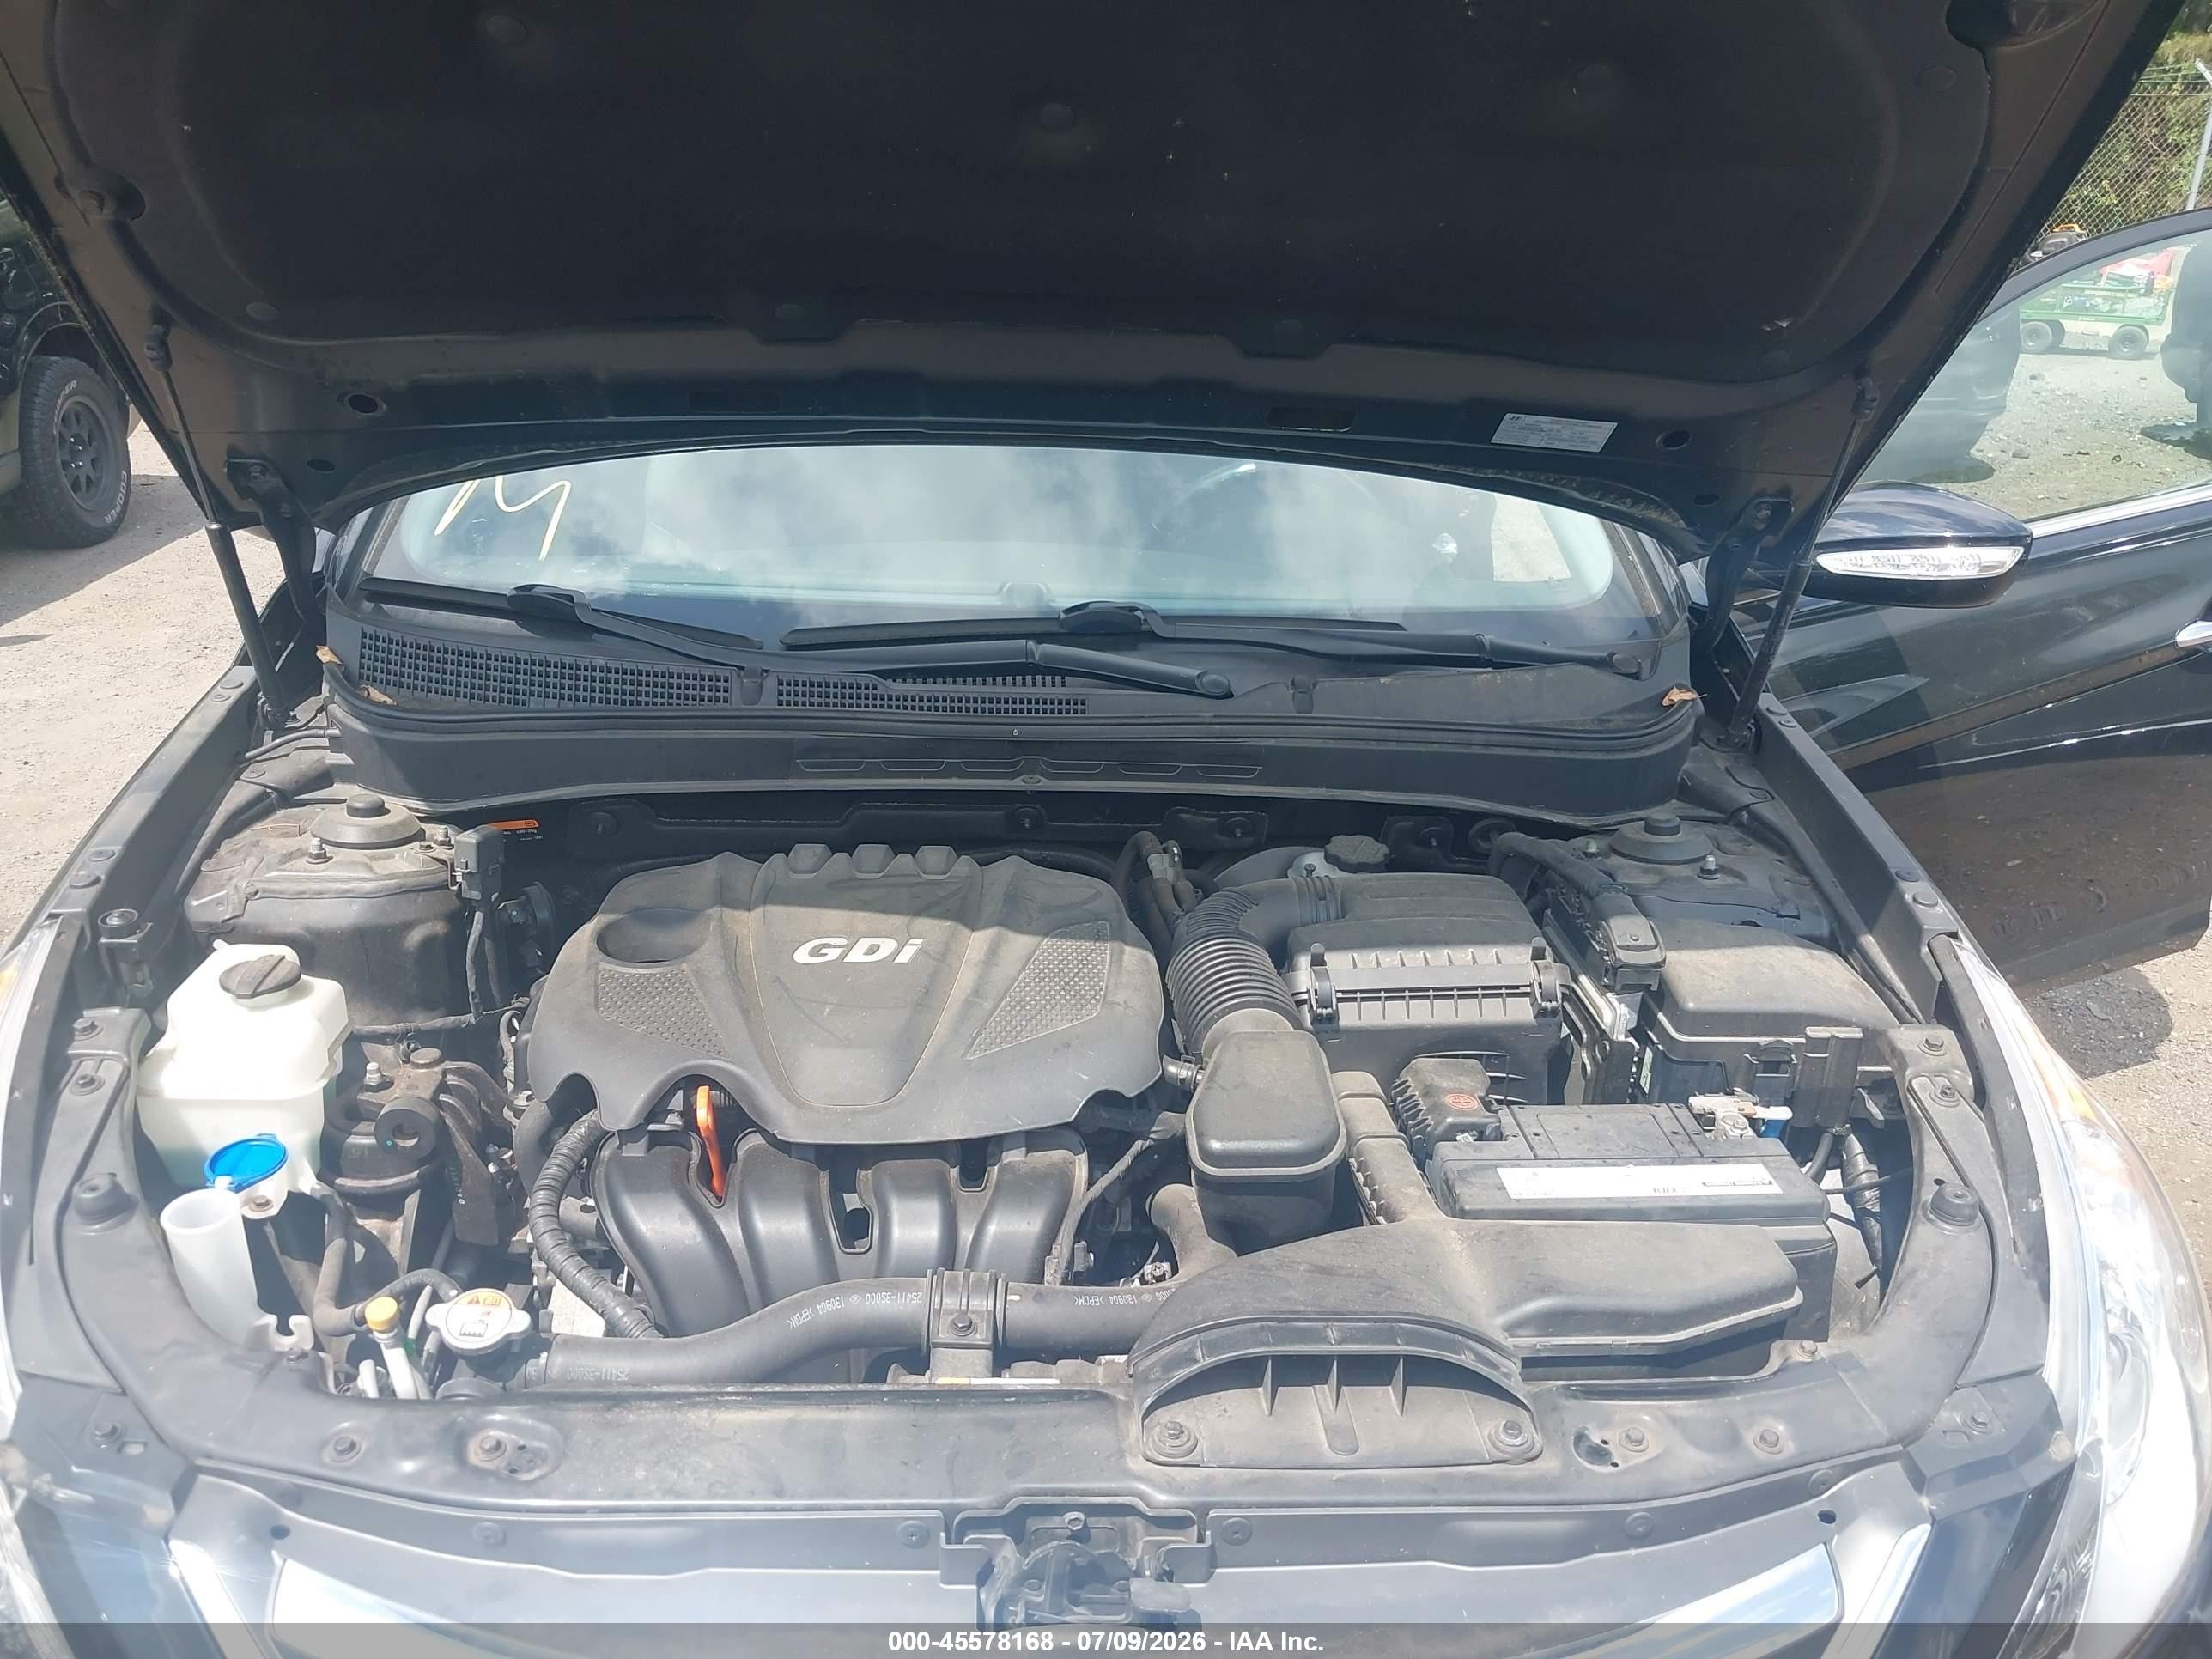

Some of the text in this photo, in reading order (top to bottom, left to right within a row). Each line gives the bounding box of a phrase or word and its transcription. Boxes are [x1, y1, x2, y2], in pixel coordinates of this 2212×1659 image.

[104, 469, 128, 524] COOPER
[792, 937, 926, 965] GDi
[817, 1296, 845, 1315] 130904
[865, 1291, 923, 1305] 25411-3S000
[1109, 1293, 1138, 1305] 130904
